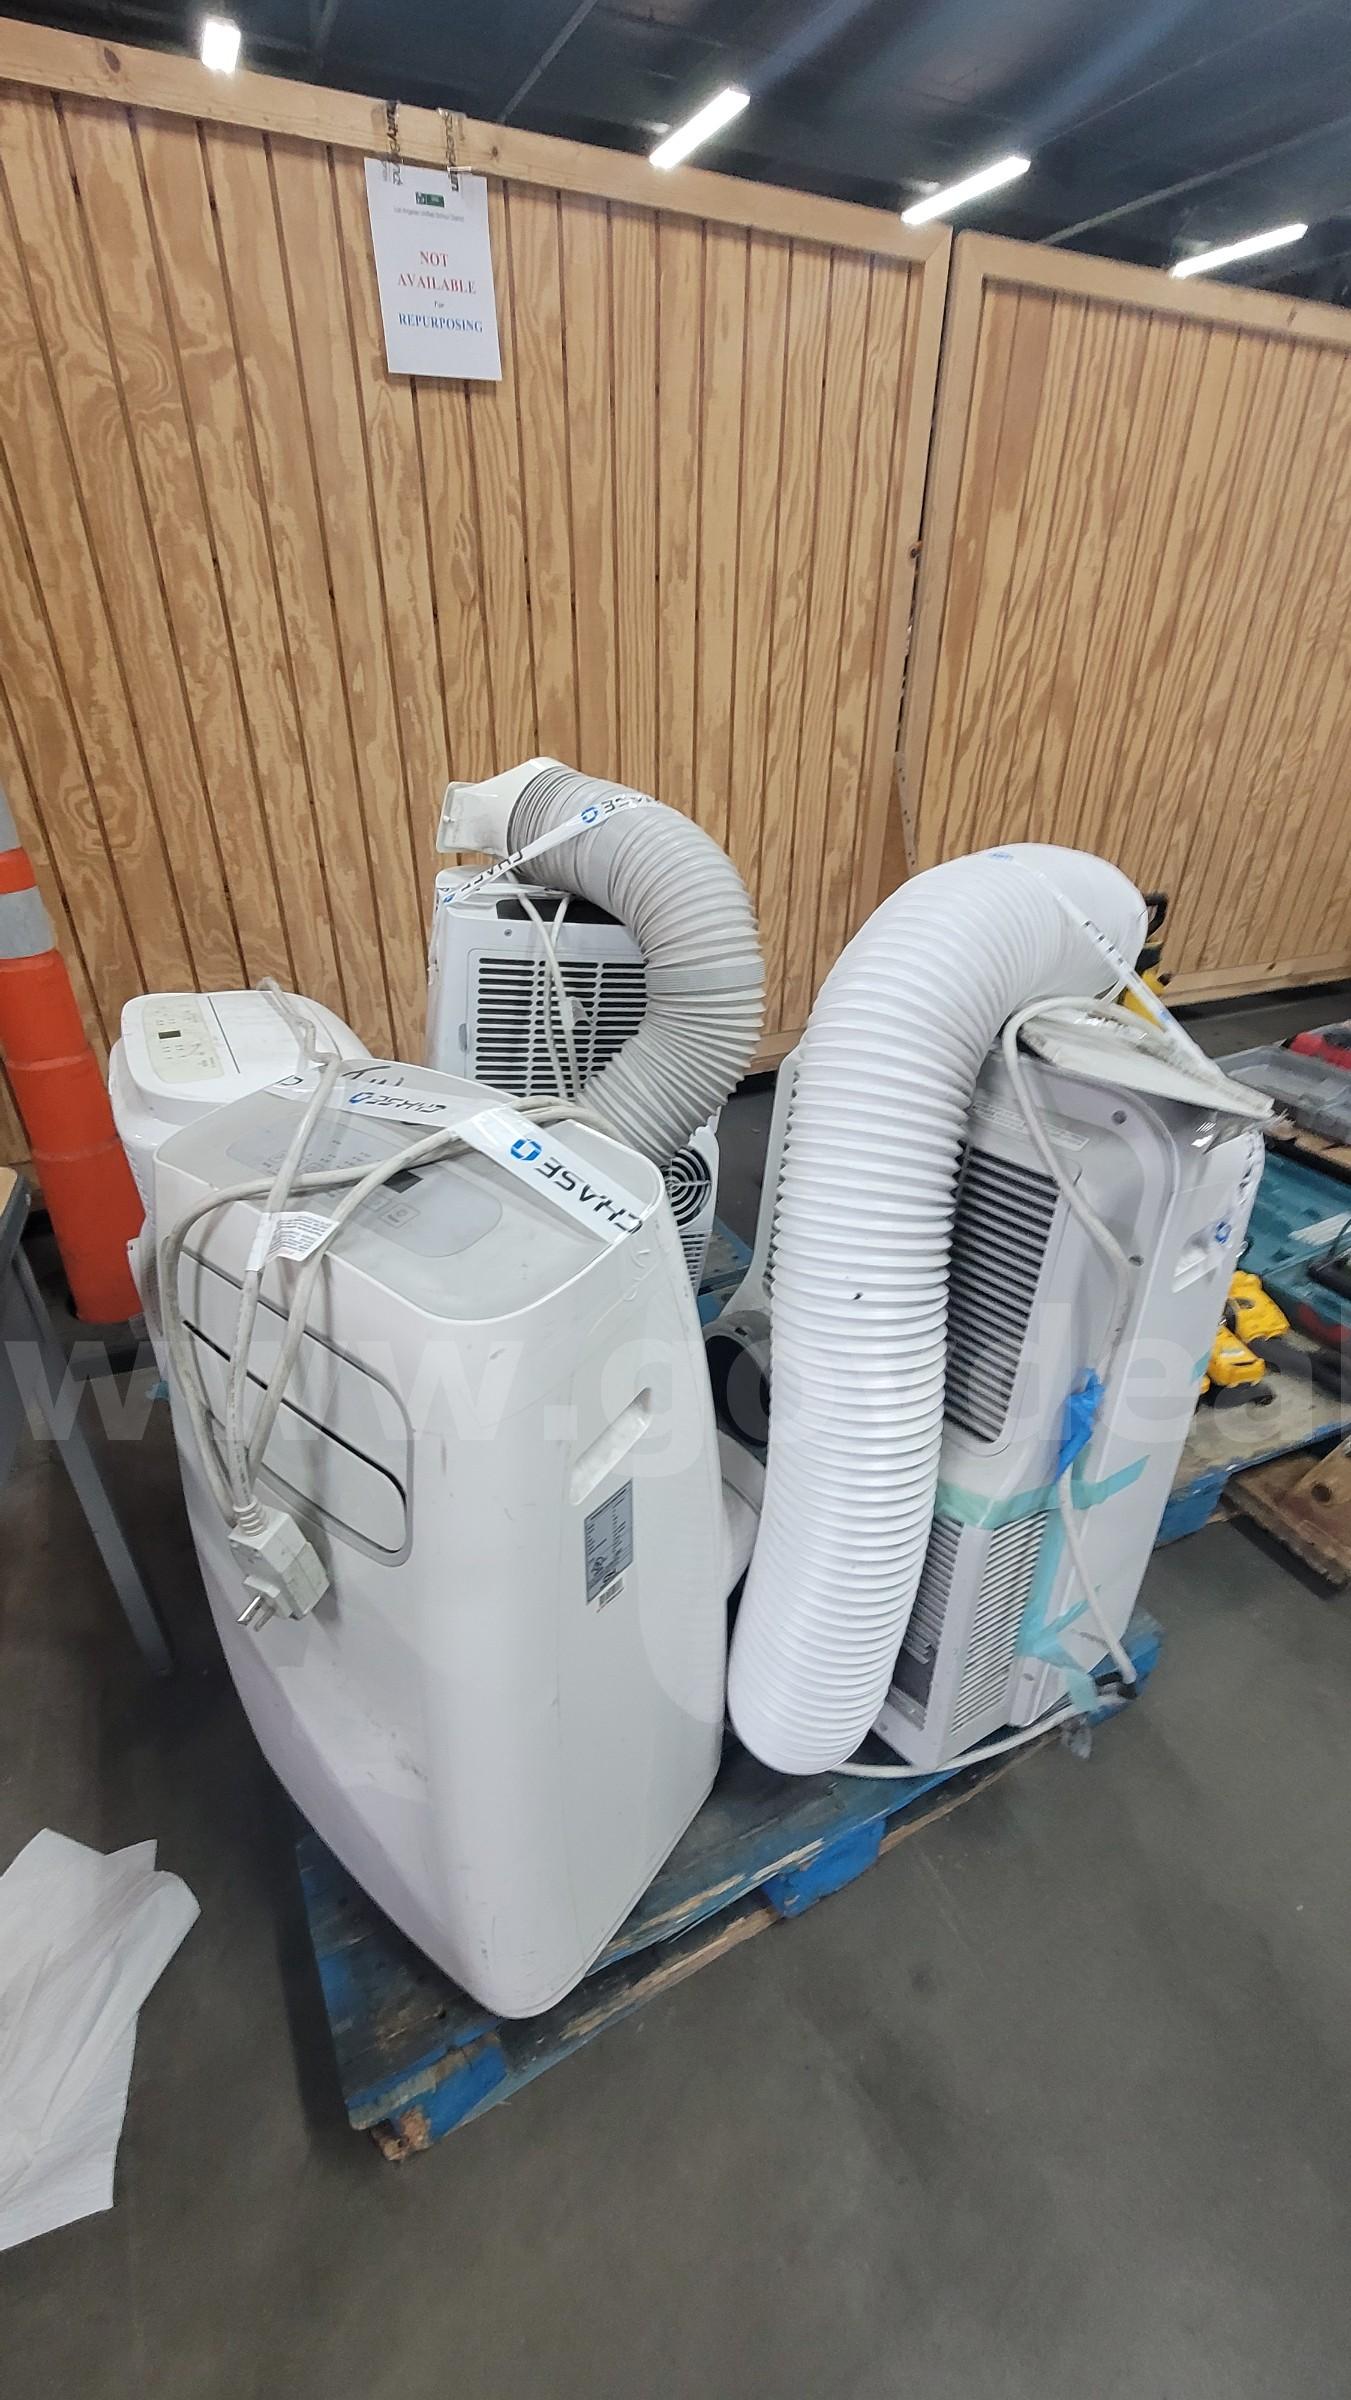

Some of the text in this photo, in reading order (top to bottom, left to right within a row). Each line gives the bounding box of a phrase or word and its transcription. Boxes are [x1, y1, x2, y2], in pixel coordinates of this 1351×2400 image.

[419, 250, 449, 268] NOT
[398, 272, 477, 295] AVAILABLE
[398, 311, 483, 333] REPURPOSING
[534, 1156, 643, 1235] CHASE
